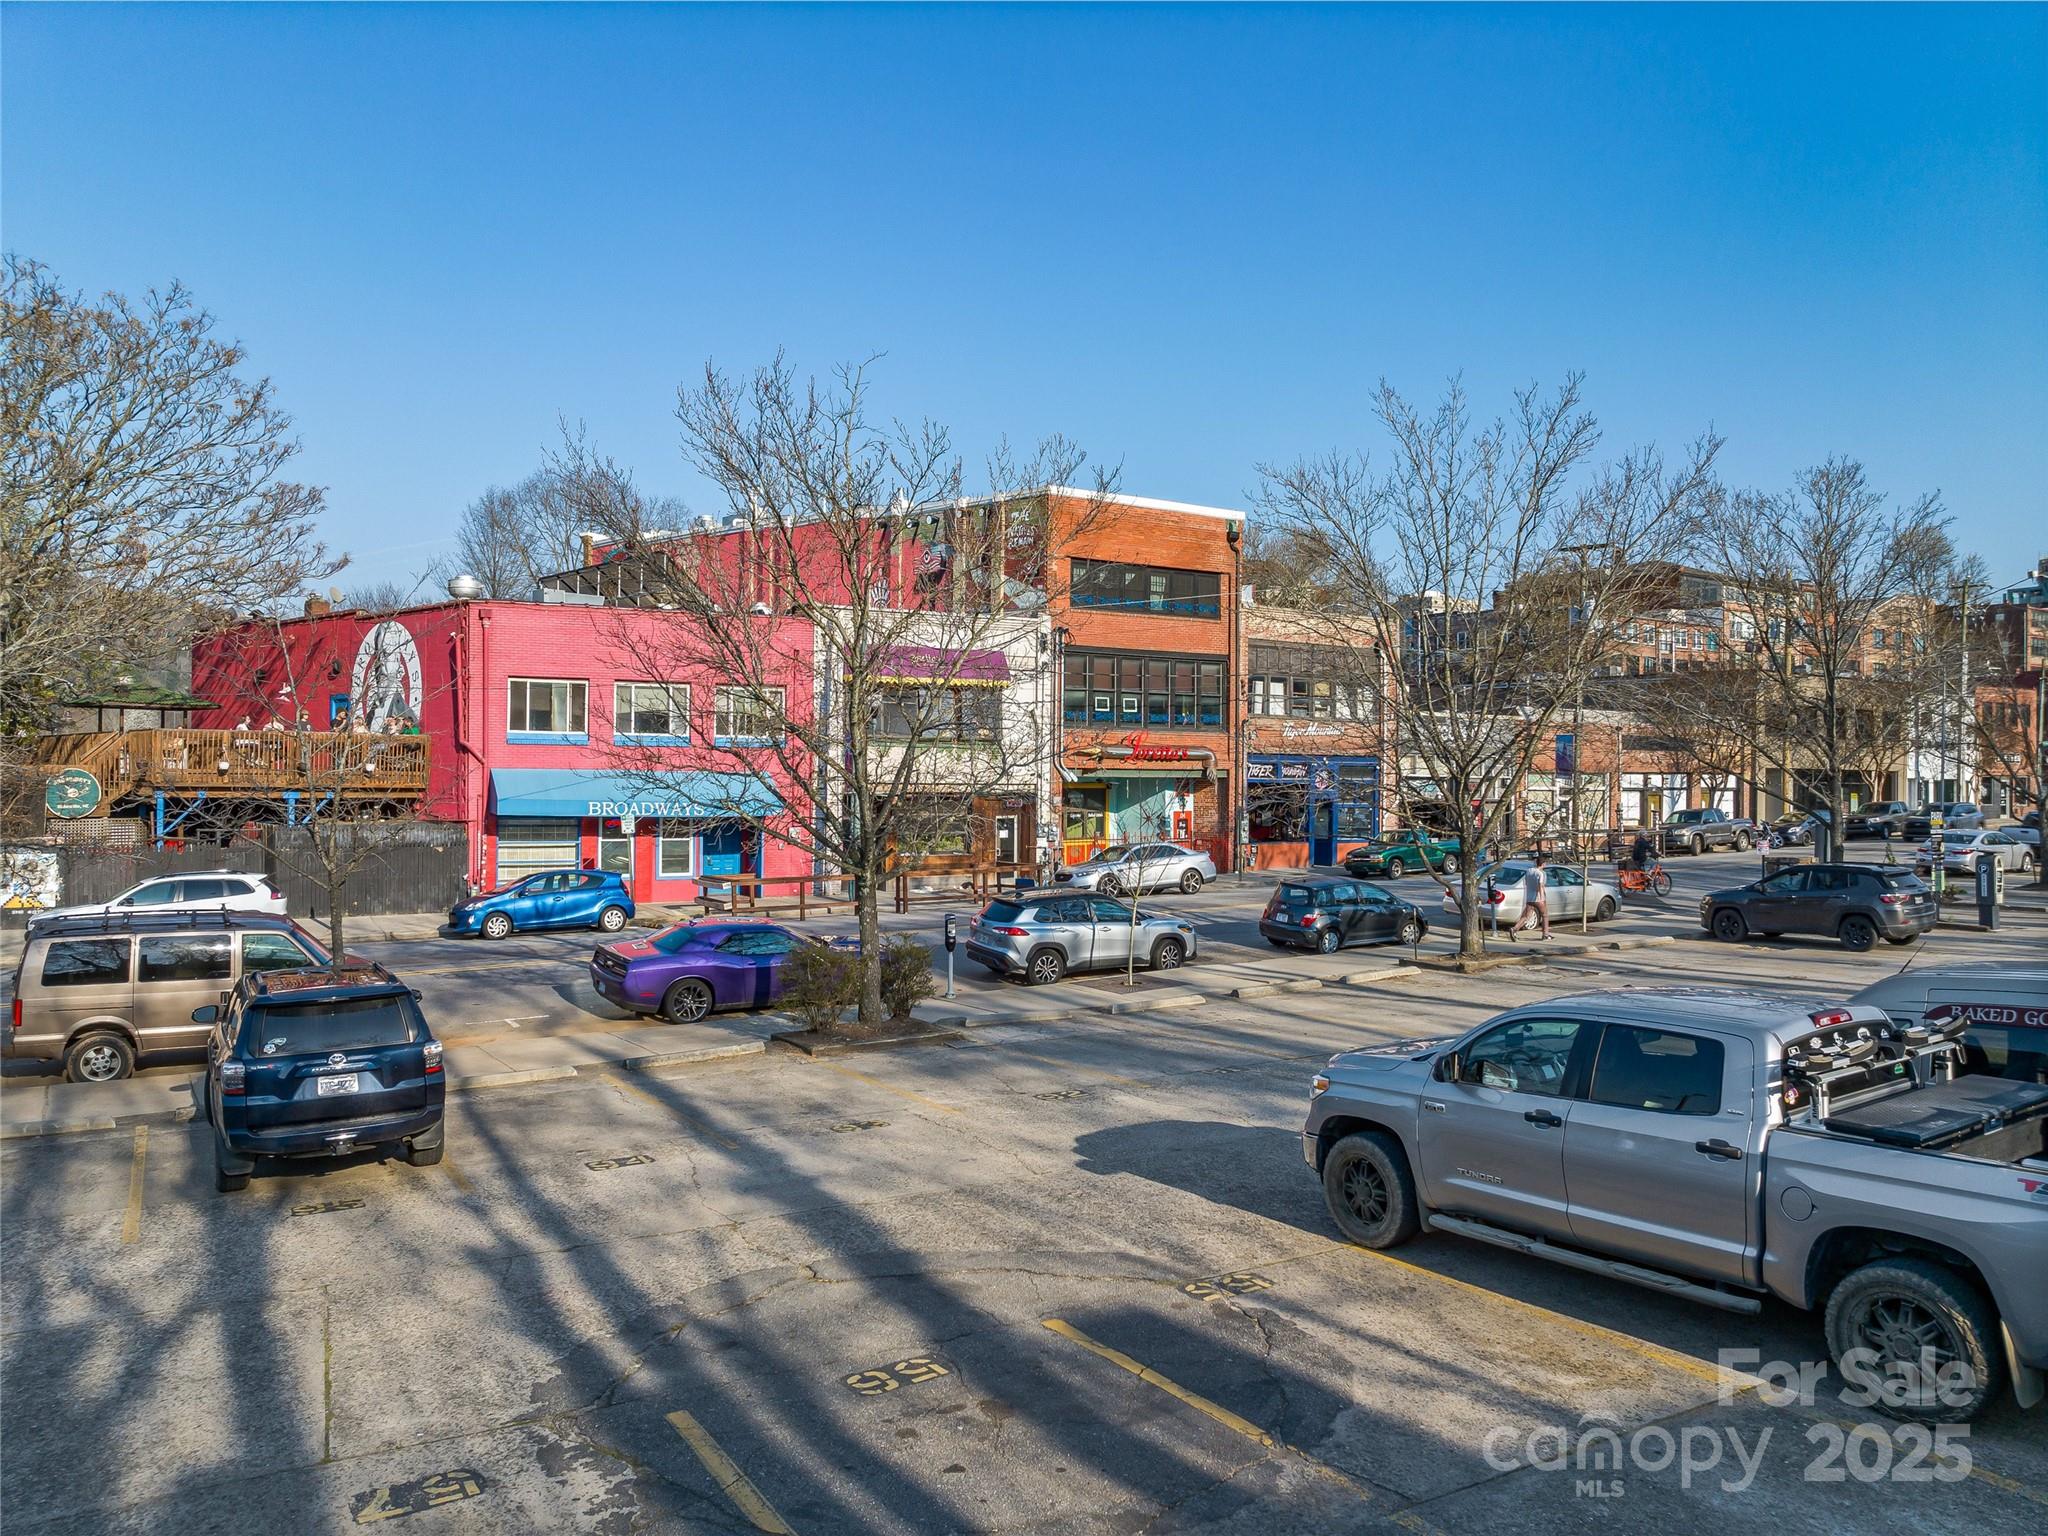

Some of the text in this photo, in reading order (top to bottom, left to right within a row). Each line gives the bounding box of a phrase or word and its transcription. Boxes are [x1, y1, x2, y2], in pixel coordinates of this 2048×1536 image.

[1283, 722, 1305, 739] Tiger
[1247, 762, 1275, 778] TIGER
[588, 801, 704, 816] BROADWAYS
[1951, 1006, 2017, 1023] BAKED
[1457, 1167, 1504, 1184] TUNDRA
[846, 1357, 949, 1396] 56
[355, 1470, 481, 1524] 57
